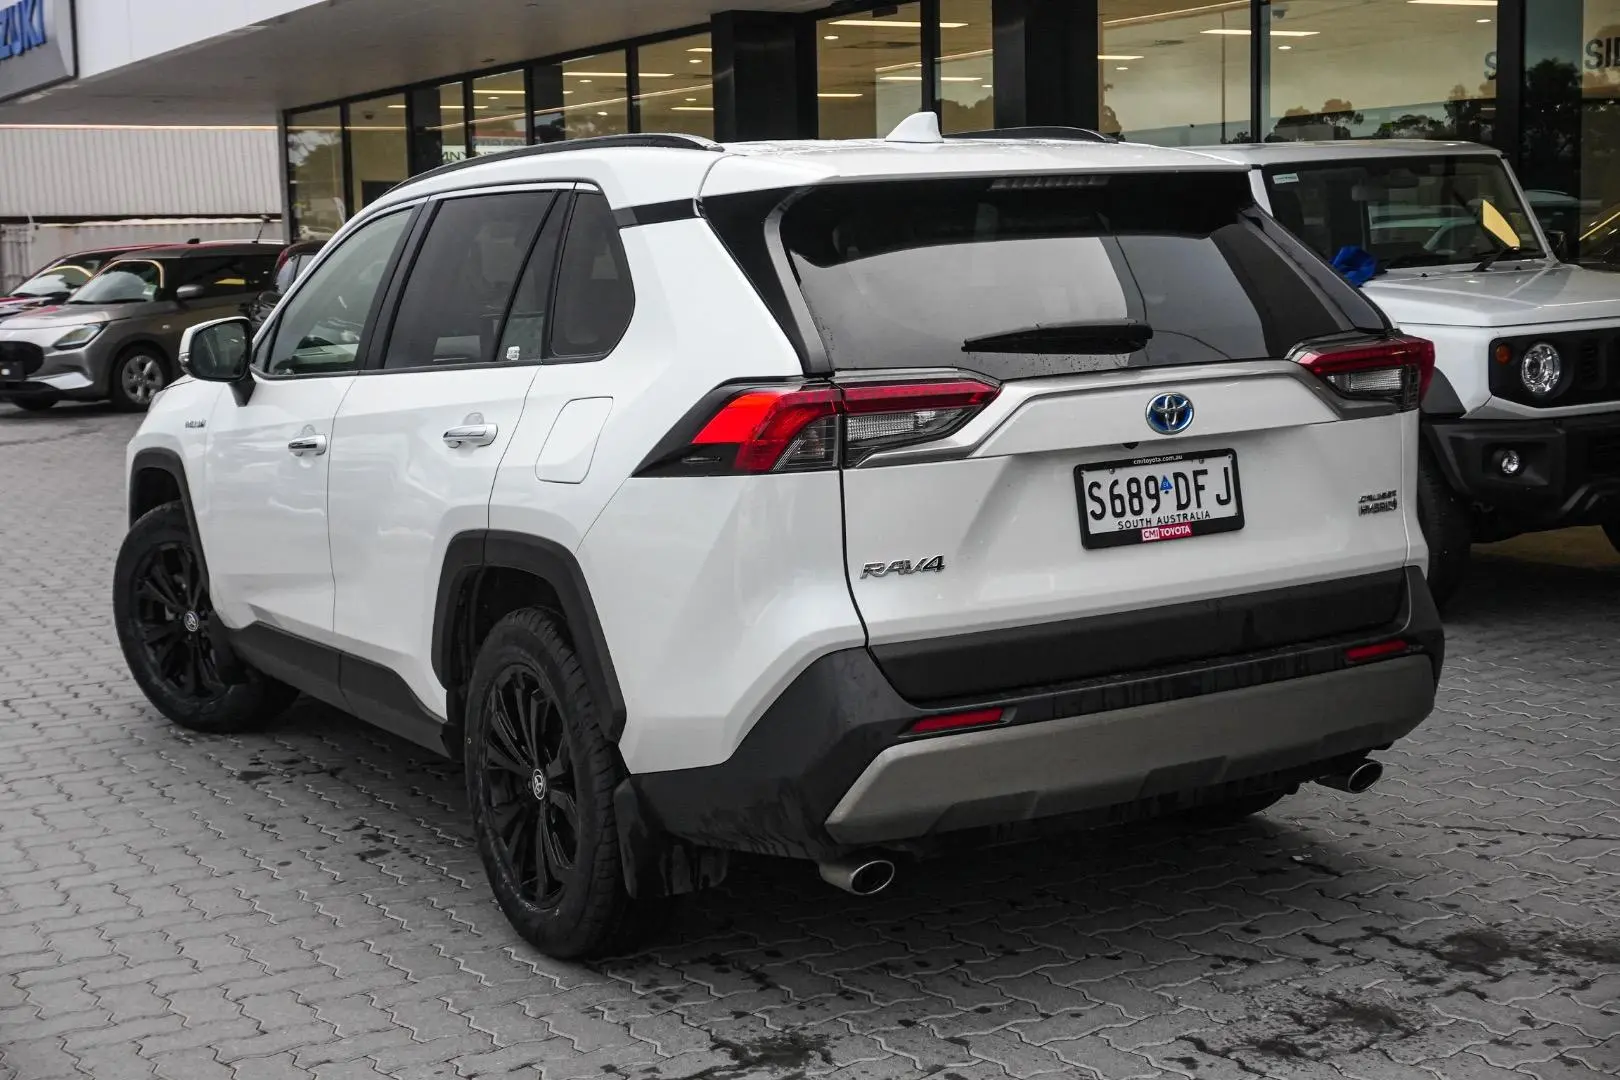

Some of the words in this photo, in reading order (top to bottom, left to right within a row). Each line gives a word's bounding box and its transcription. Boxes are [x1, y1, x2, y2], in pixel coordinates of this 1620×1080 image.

[1133, 454, 1183, 465] cmitoyota.com.au
[1088, 475, 1161, 521] S689
[1117, 517, 1152, 530] SOUTH
[1156, 510, 1211, 525] AUSTRALIA
[1143, 528, 1159, 539] CMI
[1160, 525, 1191, 537] TOYOTA
[860, 555, 945, 579] RAV4
